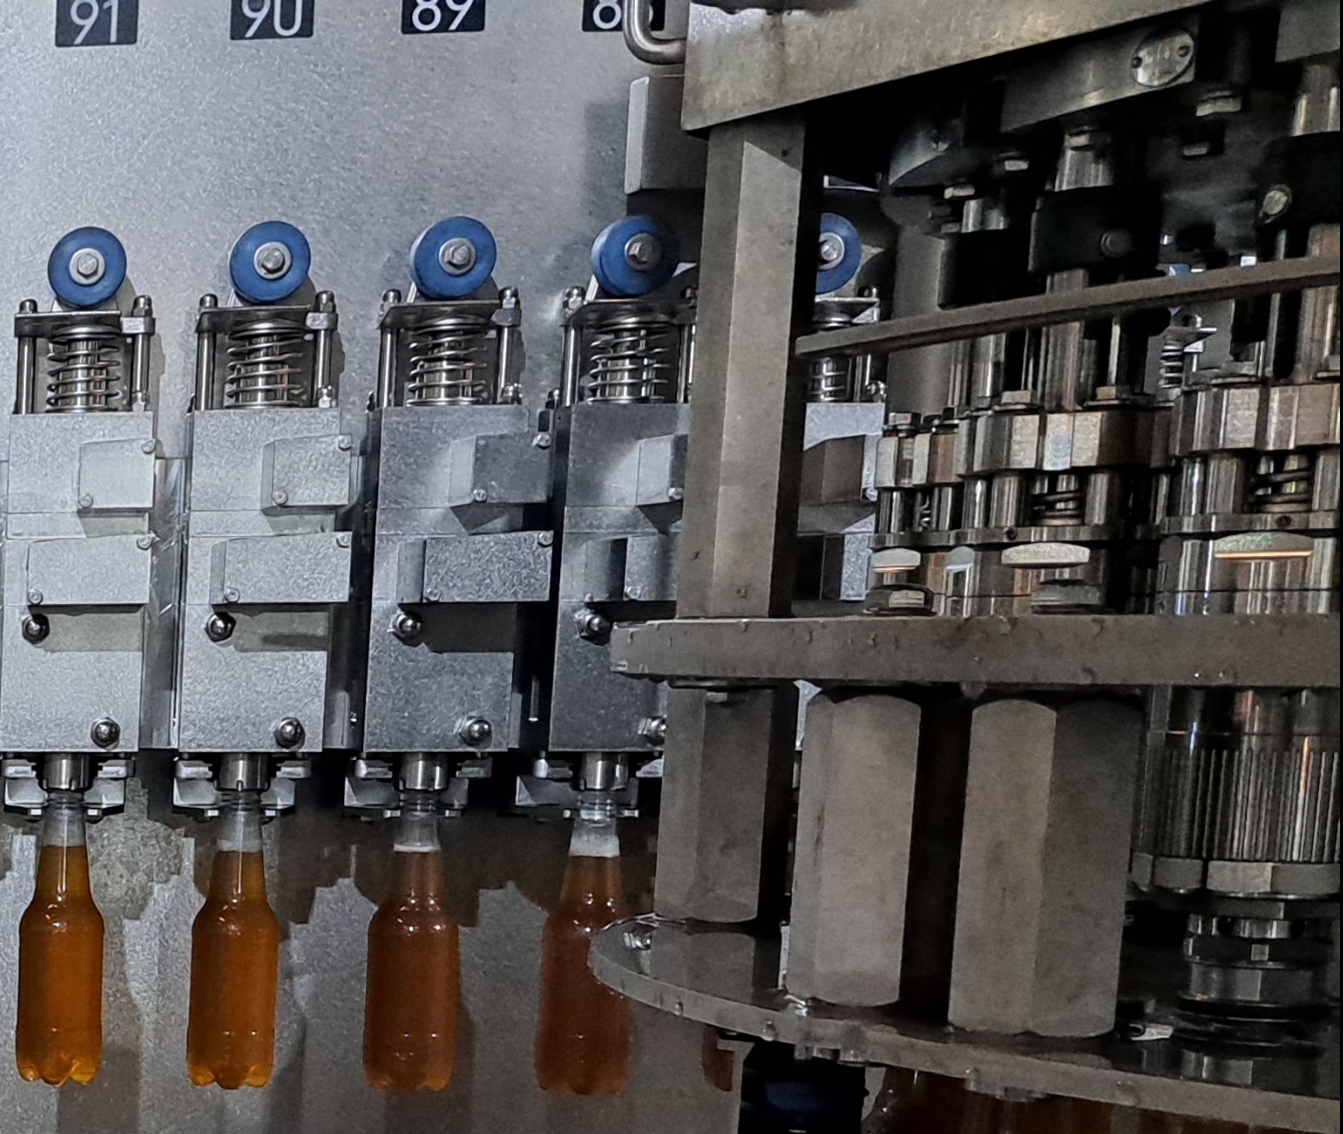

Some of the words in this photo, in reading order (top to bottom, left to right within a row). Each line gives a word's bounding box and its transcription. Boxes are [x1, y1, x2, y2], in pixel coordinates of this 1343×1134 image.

[70, 0, 119, 45] 91
[241, 0, 303, 38] 90
[411, 0, 474, 32] 89
